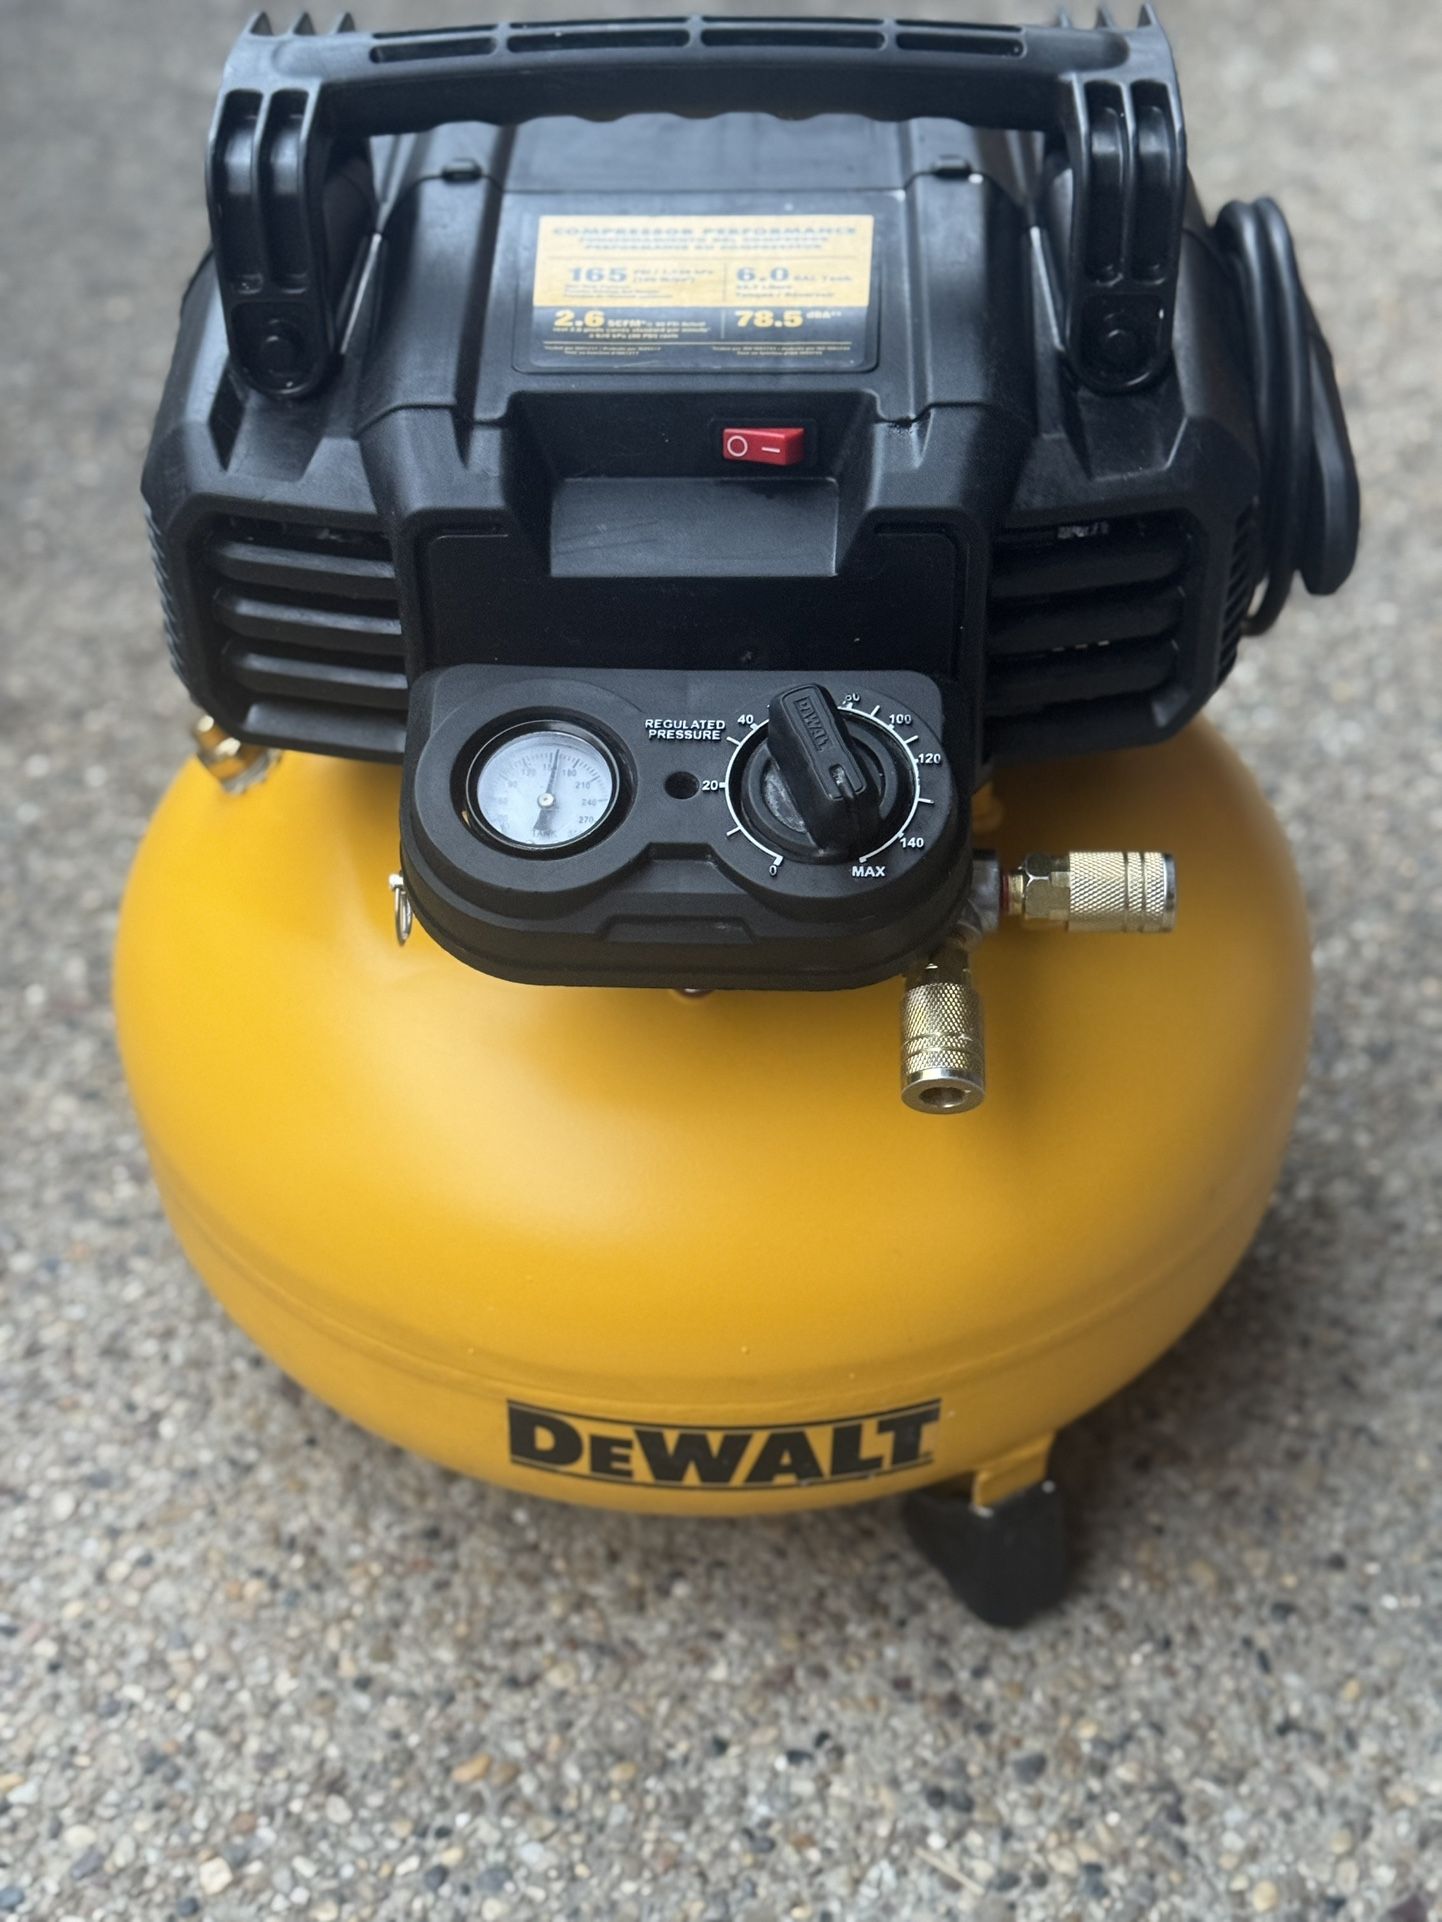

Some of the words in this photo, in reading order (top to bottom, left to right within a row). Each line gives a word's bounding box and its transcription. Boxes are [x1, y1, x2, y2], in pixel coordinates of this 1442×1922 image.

[553, 227, 693, 236] COMPRESSOR
[703, 226, 857, 235] PERFORMANCE
[569, 266, 627, 283] 165
[736, 266, 790, 282] 6.0
[553, 309, 605, 327] 2.6
[734, 309, 804, 328] 78.5
[644, 718, 726, 731] REGULATED
[737, 713, 754, 725] 40
[888, 714, 912, 725] 100
[648, 729, 721, 741] PRESSURE
[918, 753, 941, 764] 120
[575, 781, 591, 789] 210
[701, 780, 718, 791] 20
[581, 798, 597, 806] 240
[578, 816, 594, 824] 270
[900, 837, 925, 848] 140
[769, 865, 777, 876] 0
[851, 865, 886, 878] MAX
[507, 1403, 940, 1486] DEWALT
